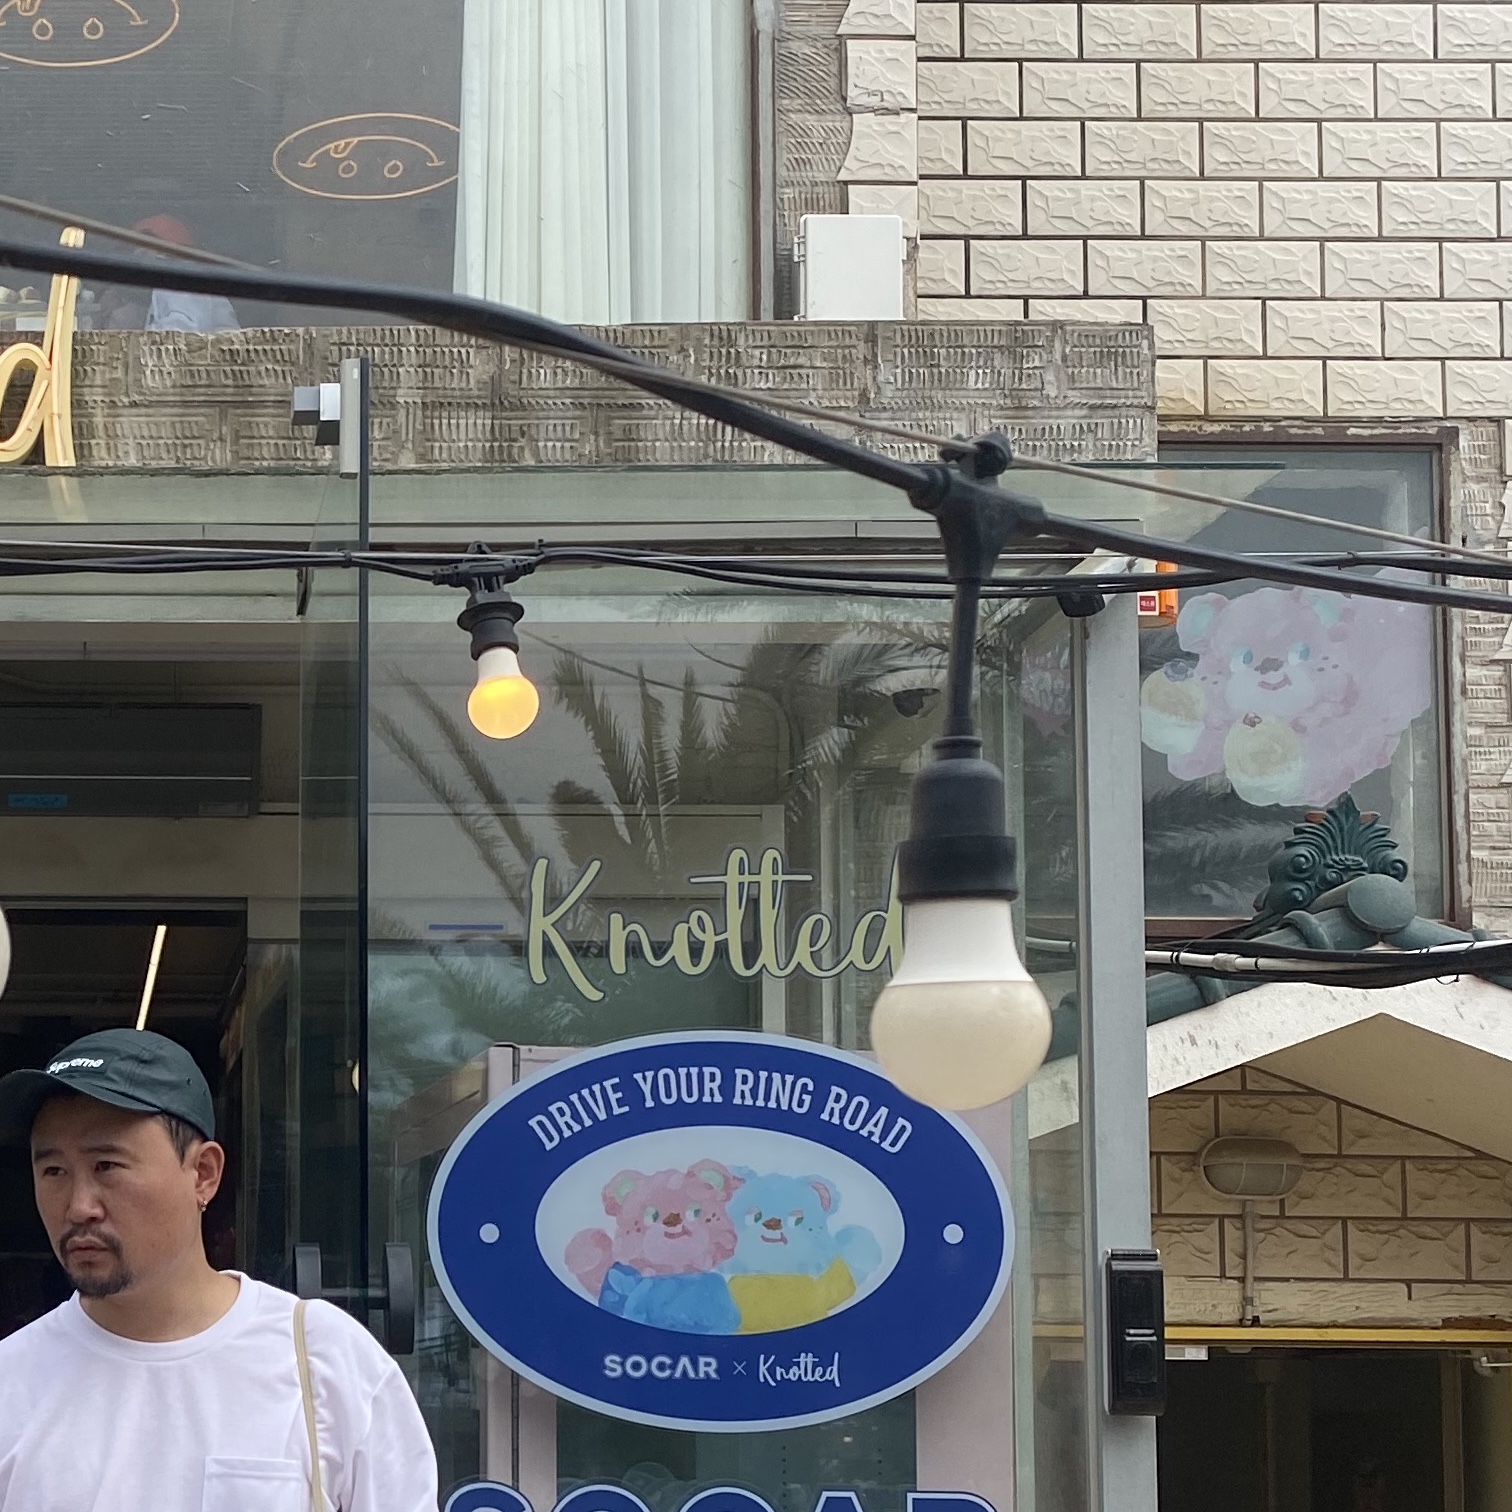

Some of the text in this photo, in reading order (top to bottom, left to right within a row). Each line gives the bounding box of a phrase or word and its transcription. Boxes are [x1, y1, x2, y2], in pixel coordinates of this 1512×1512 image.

[528, 1066, 912, 1154] DRIVE YOUR RING ROAD
[603, 1354, 720, 1380] SOCAR
[758, 1352, 840, 1387] Knotted
